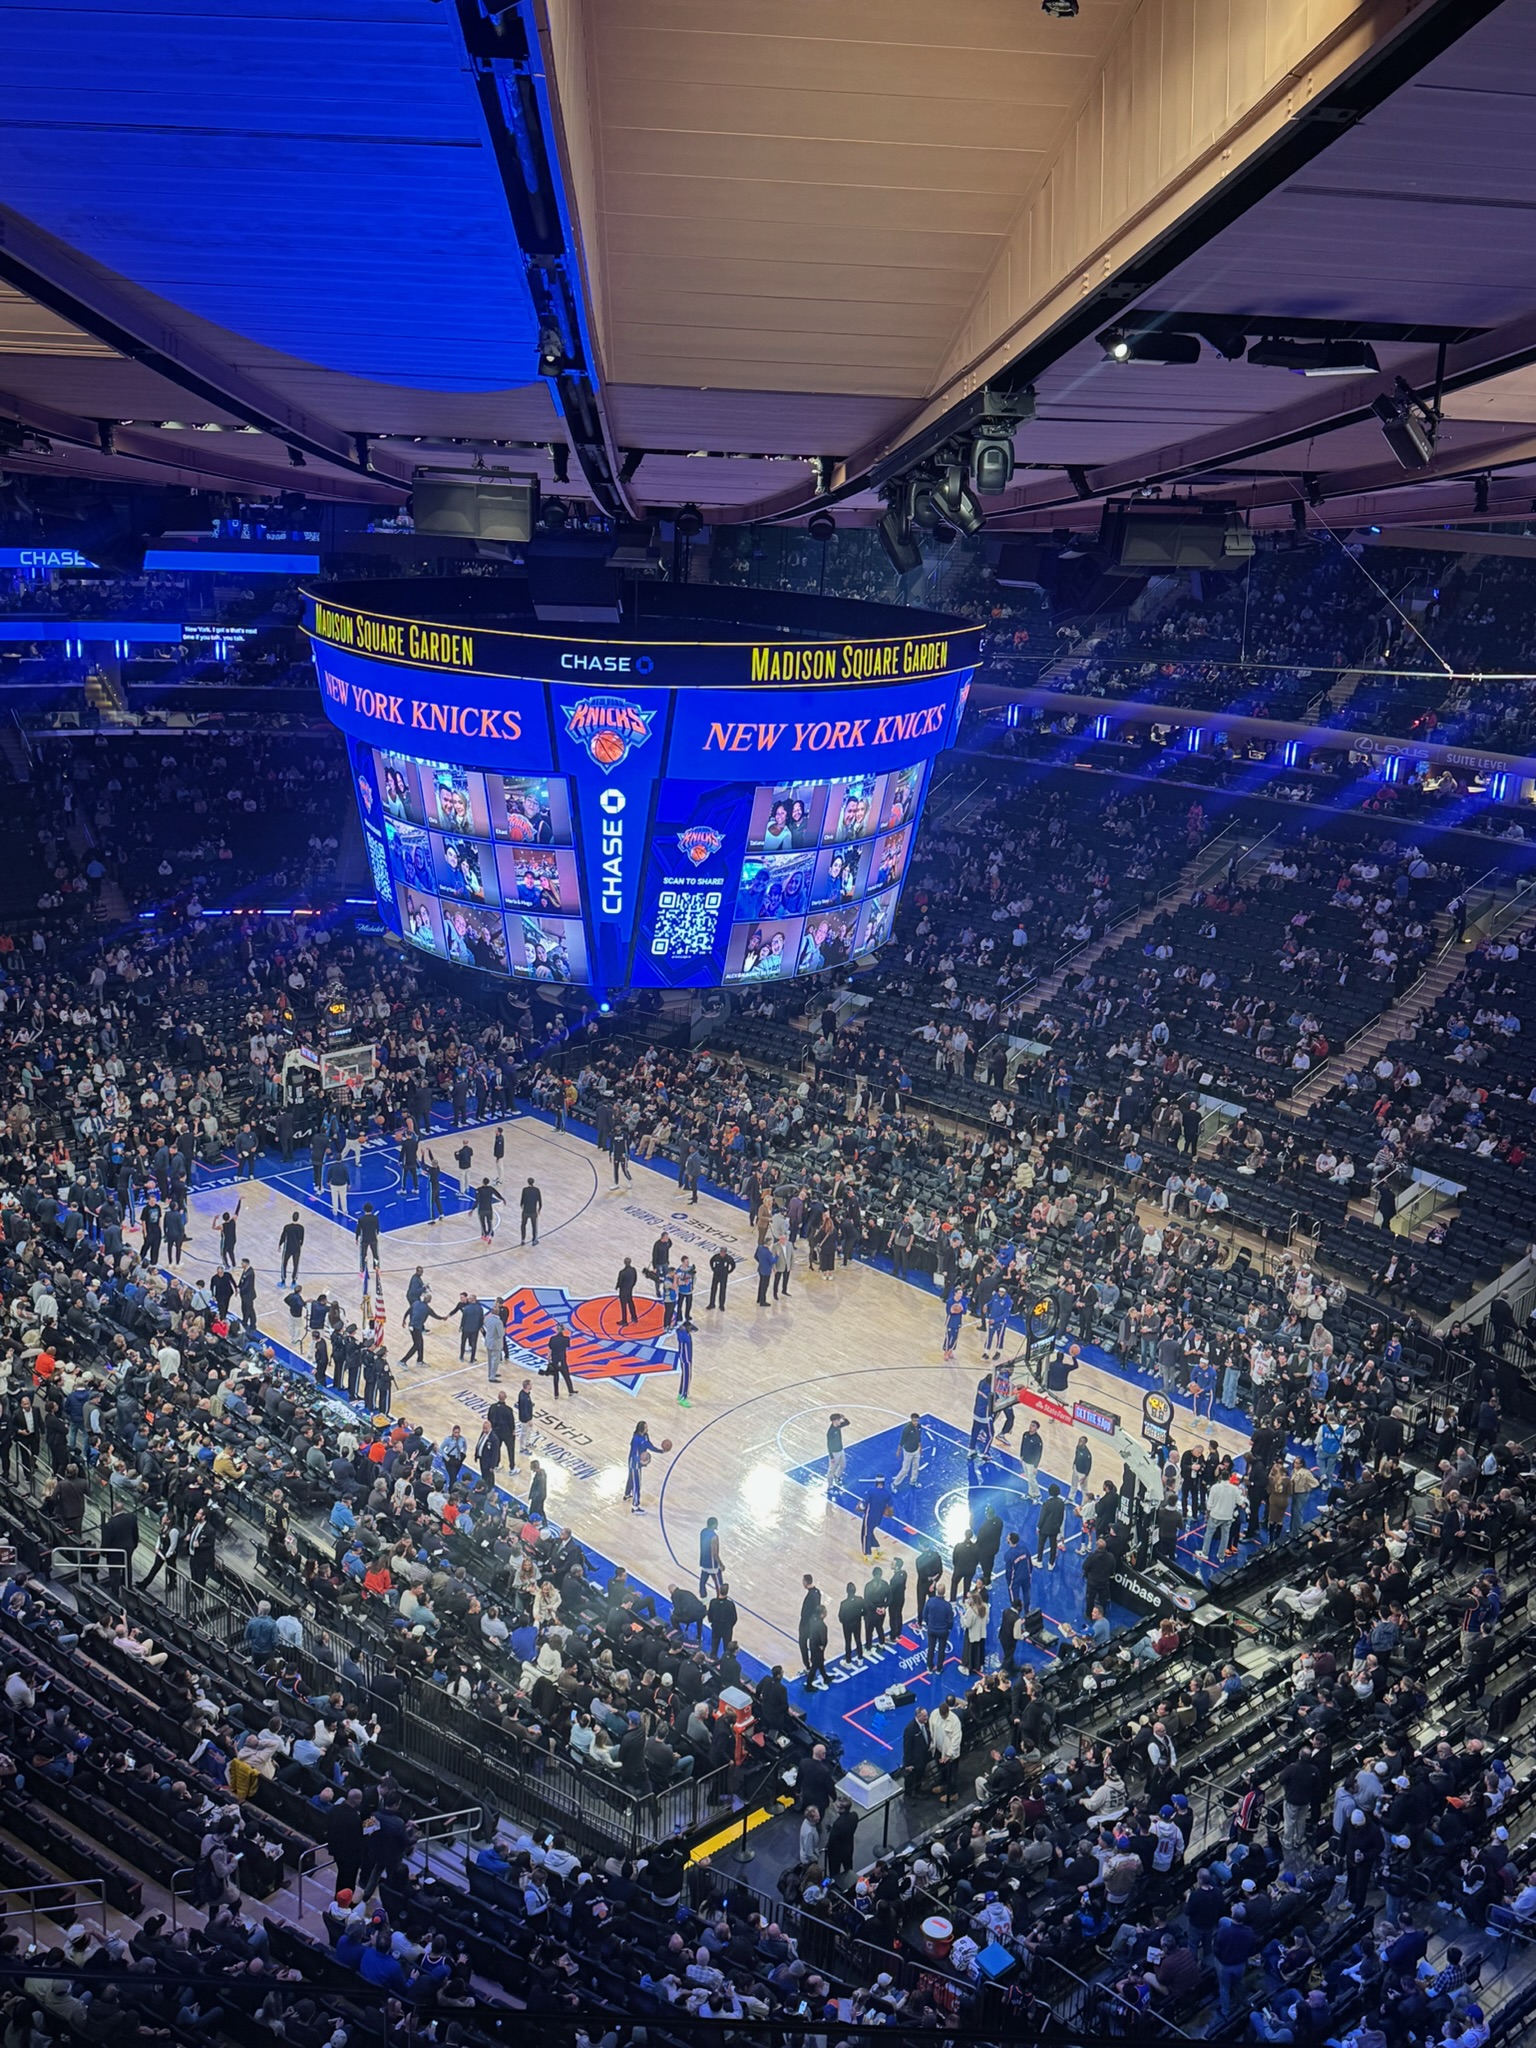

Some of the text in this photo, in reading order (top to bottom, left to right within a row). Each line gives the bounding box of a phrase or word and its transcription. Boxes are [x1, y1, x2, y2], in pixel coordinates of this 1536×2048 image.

[20, 551, 86, 566] CHASE
[315, 602, 474, 667] MADISON SQUARE GARDEN
[560, 654, 632, 673] CHASE
[751, 647, 836, 682] MADISON
[841, 645, 899, 680] SQUARE
[903, 640, 948, 674] GARDEN
[323, 670, 522, 741] NEW YORK KNICKS
[568, 703, 647, 736] KNICKS
[702, 702, 947, 752] NEW YORK KNICKS
[1374, 743, 1429, 759] LEXUS
[1446, 753, 1508, 772] SUITE LEVEL
[602, 818, 623, 914] CHASE
[663, 876, 724, 886] SCAN TO SHARE!
[684, 1218, 738, 1243] CHASE
[532, 1408, 593, 1446] CHASE
[1076, 1406, 1086, 1420] GET
[1112, 1573, 1162, 1608] oinbase
